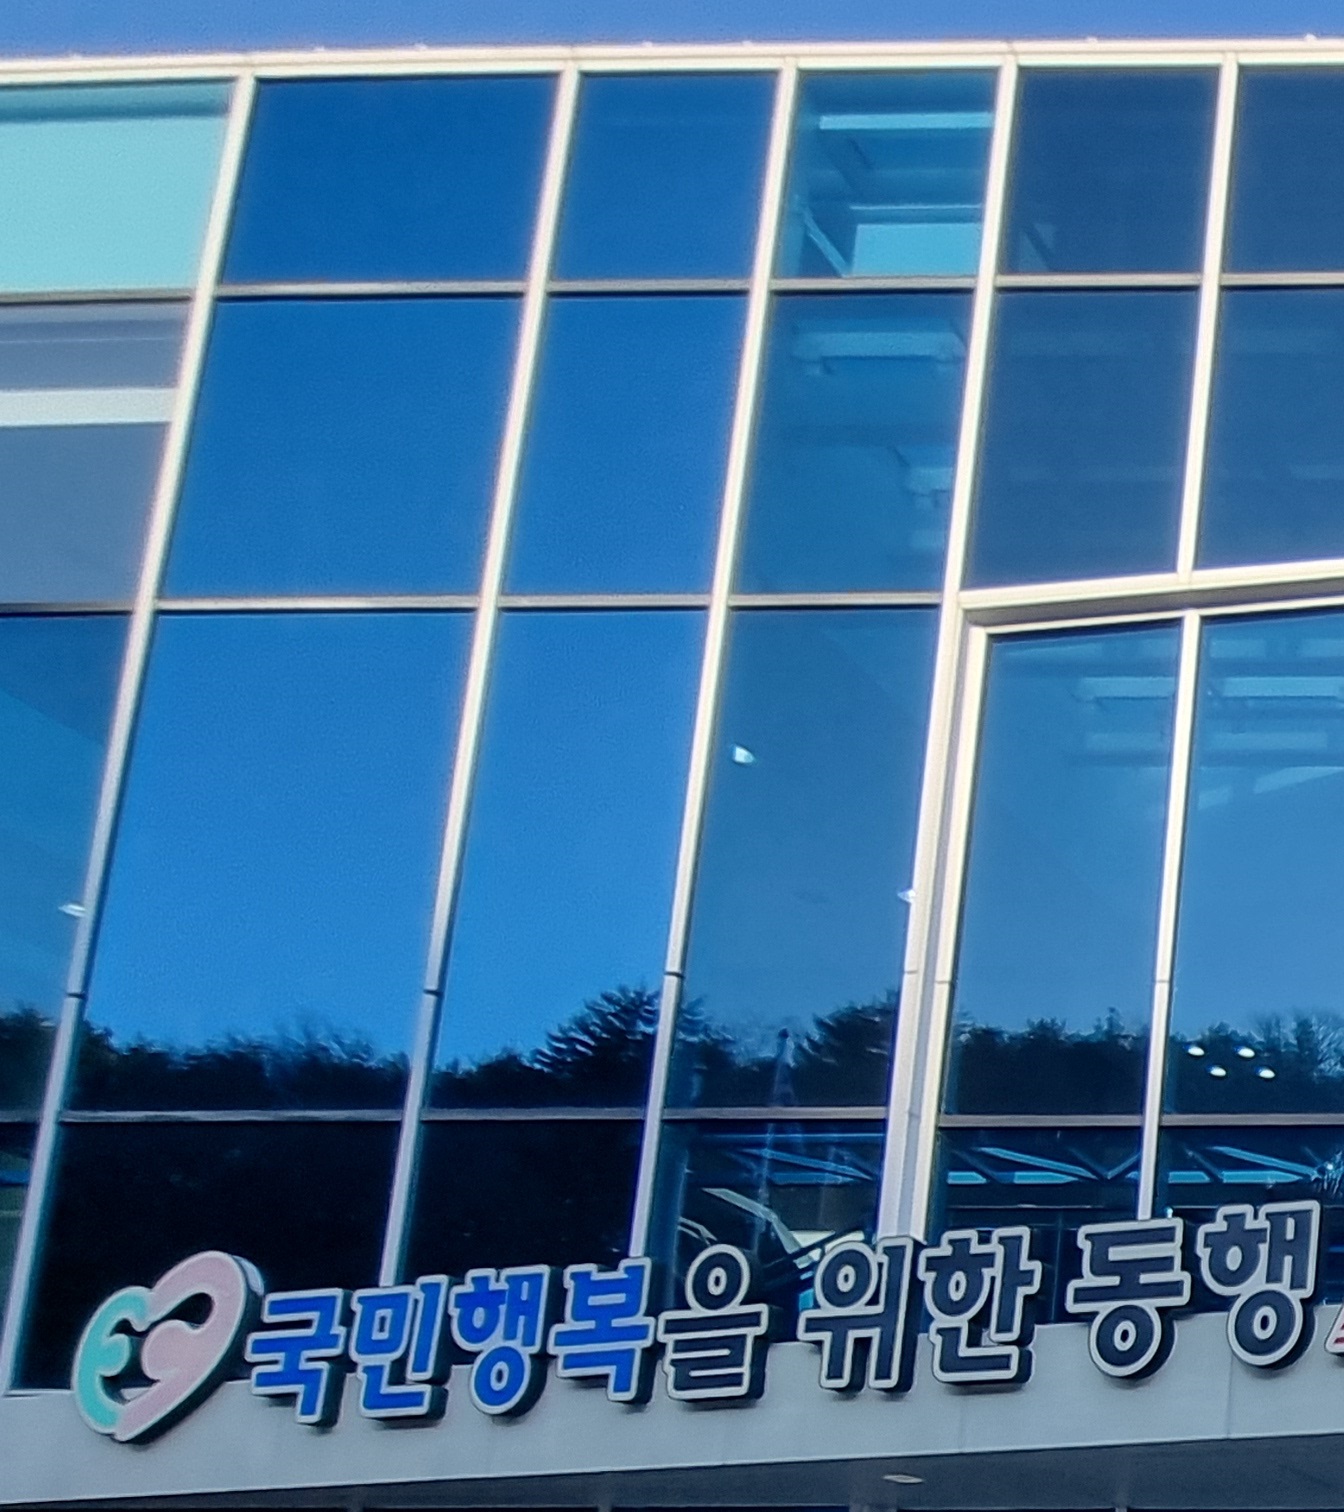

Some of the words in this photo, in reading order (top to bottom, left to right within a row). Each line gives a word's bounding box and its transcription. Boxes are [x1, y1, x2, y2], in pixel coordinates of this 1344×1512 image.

[246, 1245, 769, 1425] 국민행복을
[799, 1226, 1041, 1389] 위한
[1065, 1200, 1320, 1378] 동행
